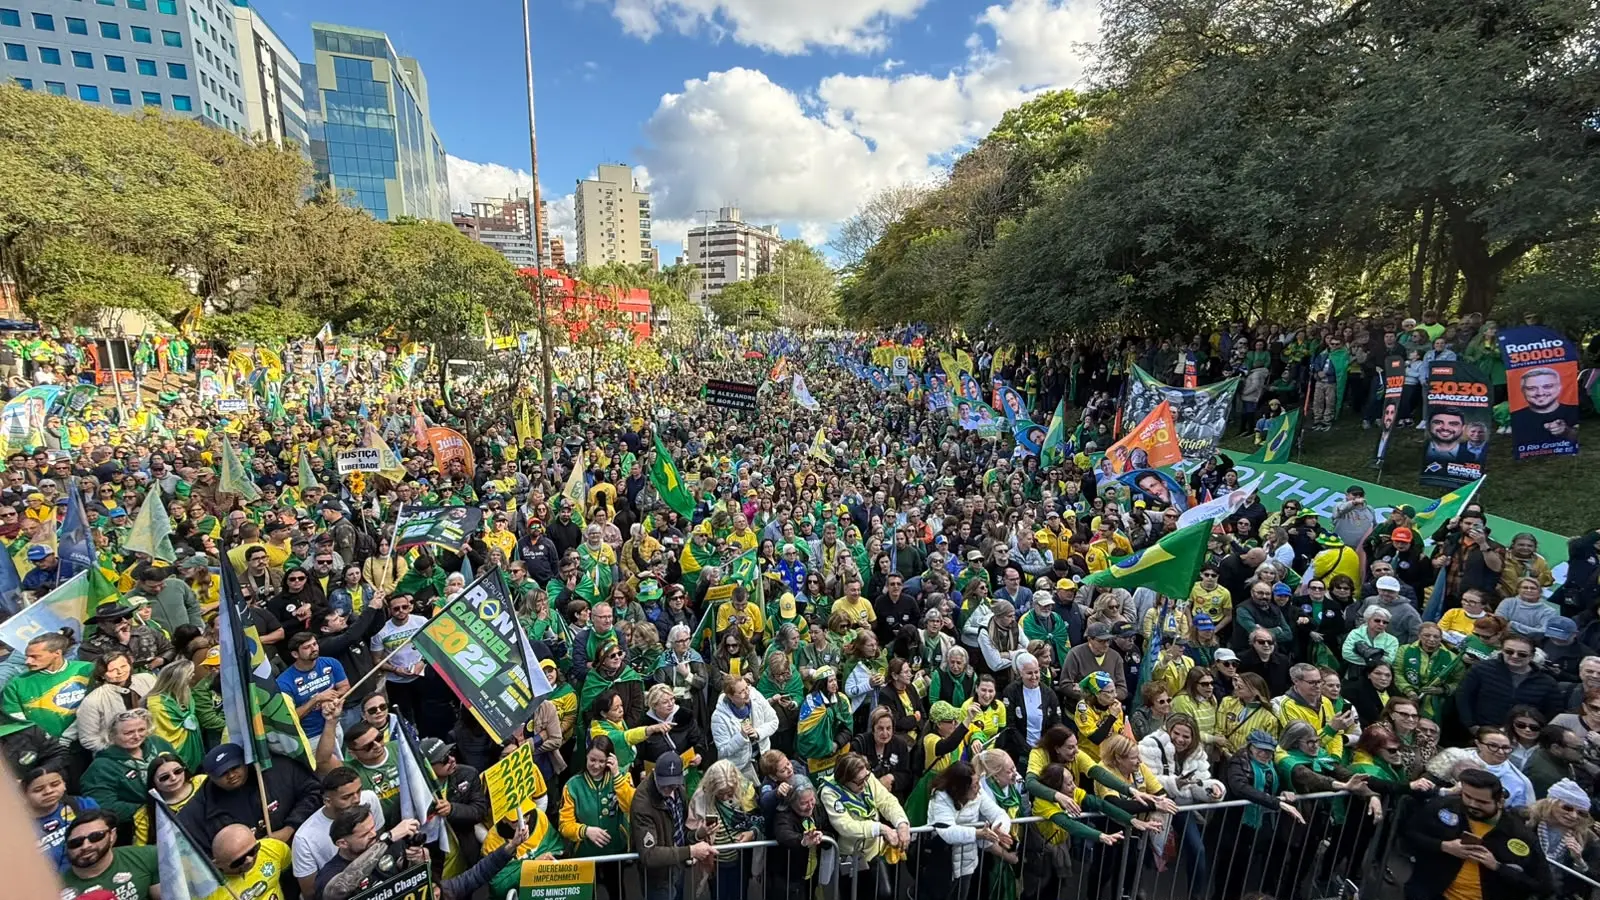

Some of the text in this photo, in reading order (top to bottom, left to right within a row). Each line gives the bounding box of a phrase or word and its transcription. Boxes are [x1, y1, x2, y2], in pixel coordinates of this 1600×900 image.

[1505, 339, 1563, 354] Ramiro
[1509, 347, 1566, 363] 30000
[1430, 381, 1488, 396] 3030
[717, 390, 756, 401] ALEXANDRE
[1427, 394, 1489, 402] CAMOZZATO
[716, 398, 745, 407] MORAES
[1541, 440, 1571, 449] Grande
[340, 450, 378, 460] JUSTIÇA
[440, 448, 465, 461] Zarco
[1447, 464, 1481, 475] MARCEL
[450, 601, 511, 663] GABRIEL
[426, 617, 497, 682] 2022
[501, 744, 531, 778] 222
[504, 761, 533, 796] 222
[507, 776, 536, 811] 222
[537, 864, 572, 873] QUEREMOS
[394, 870, 428, 893] Chagas
[533, 873, 580, 883] IMPEACHMENT
[531, 886, 581, 897] DOS MINISTROS
